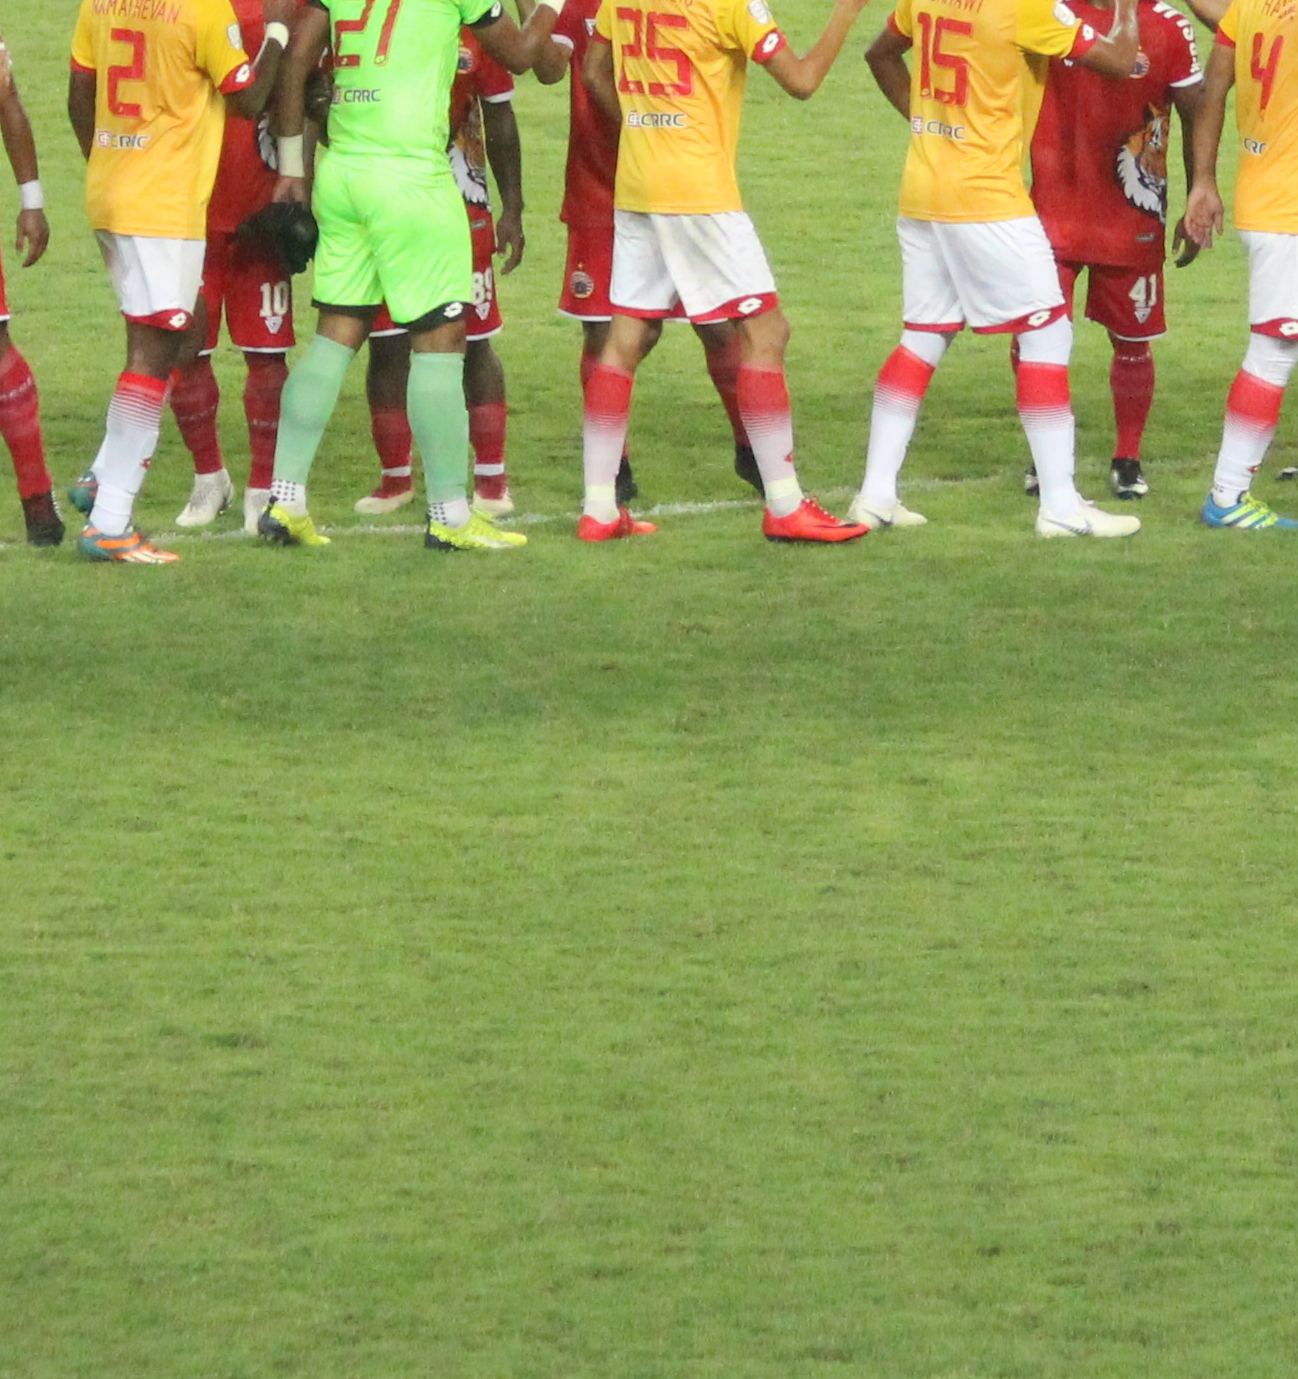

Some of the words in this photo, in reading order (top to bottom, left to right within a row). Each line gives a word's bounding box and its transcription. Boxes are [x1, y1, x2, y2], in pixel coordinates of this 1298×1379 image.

[107, 27, 146, 117] 2
[343, 88, 381, 103] CRRC
[615, 6, 694, 98] 25
[917, 11, 974, 108] 15
[1251, 31, 1286, 122] 4
[258, 280, 290, 317] 10
[1128, 273, 1158, 308] 41
